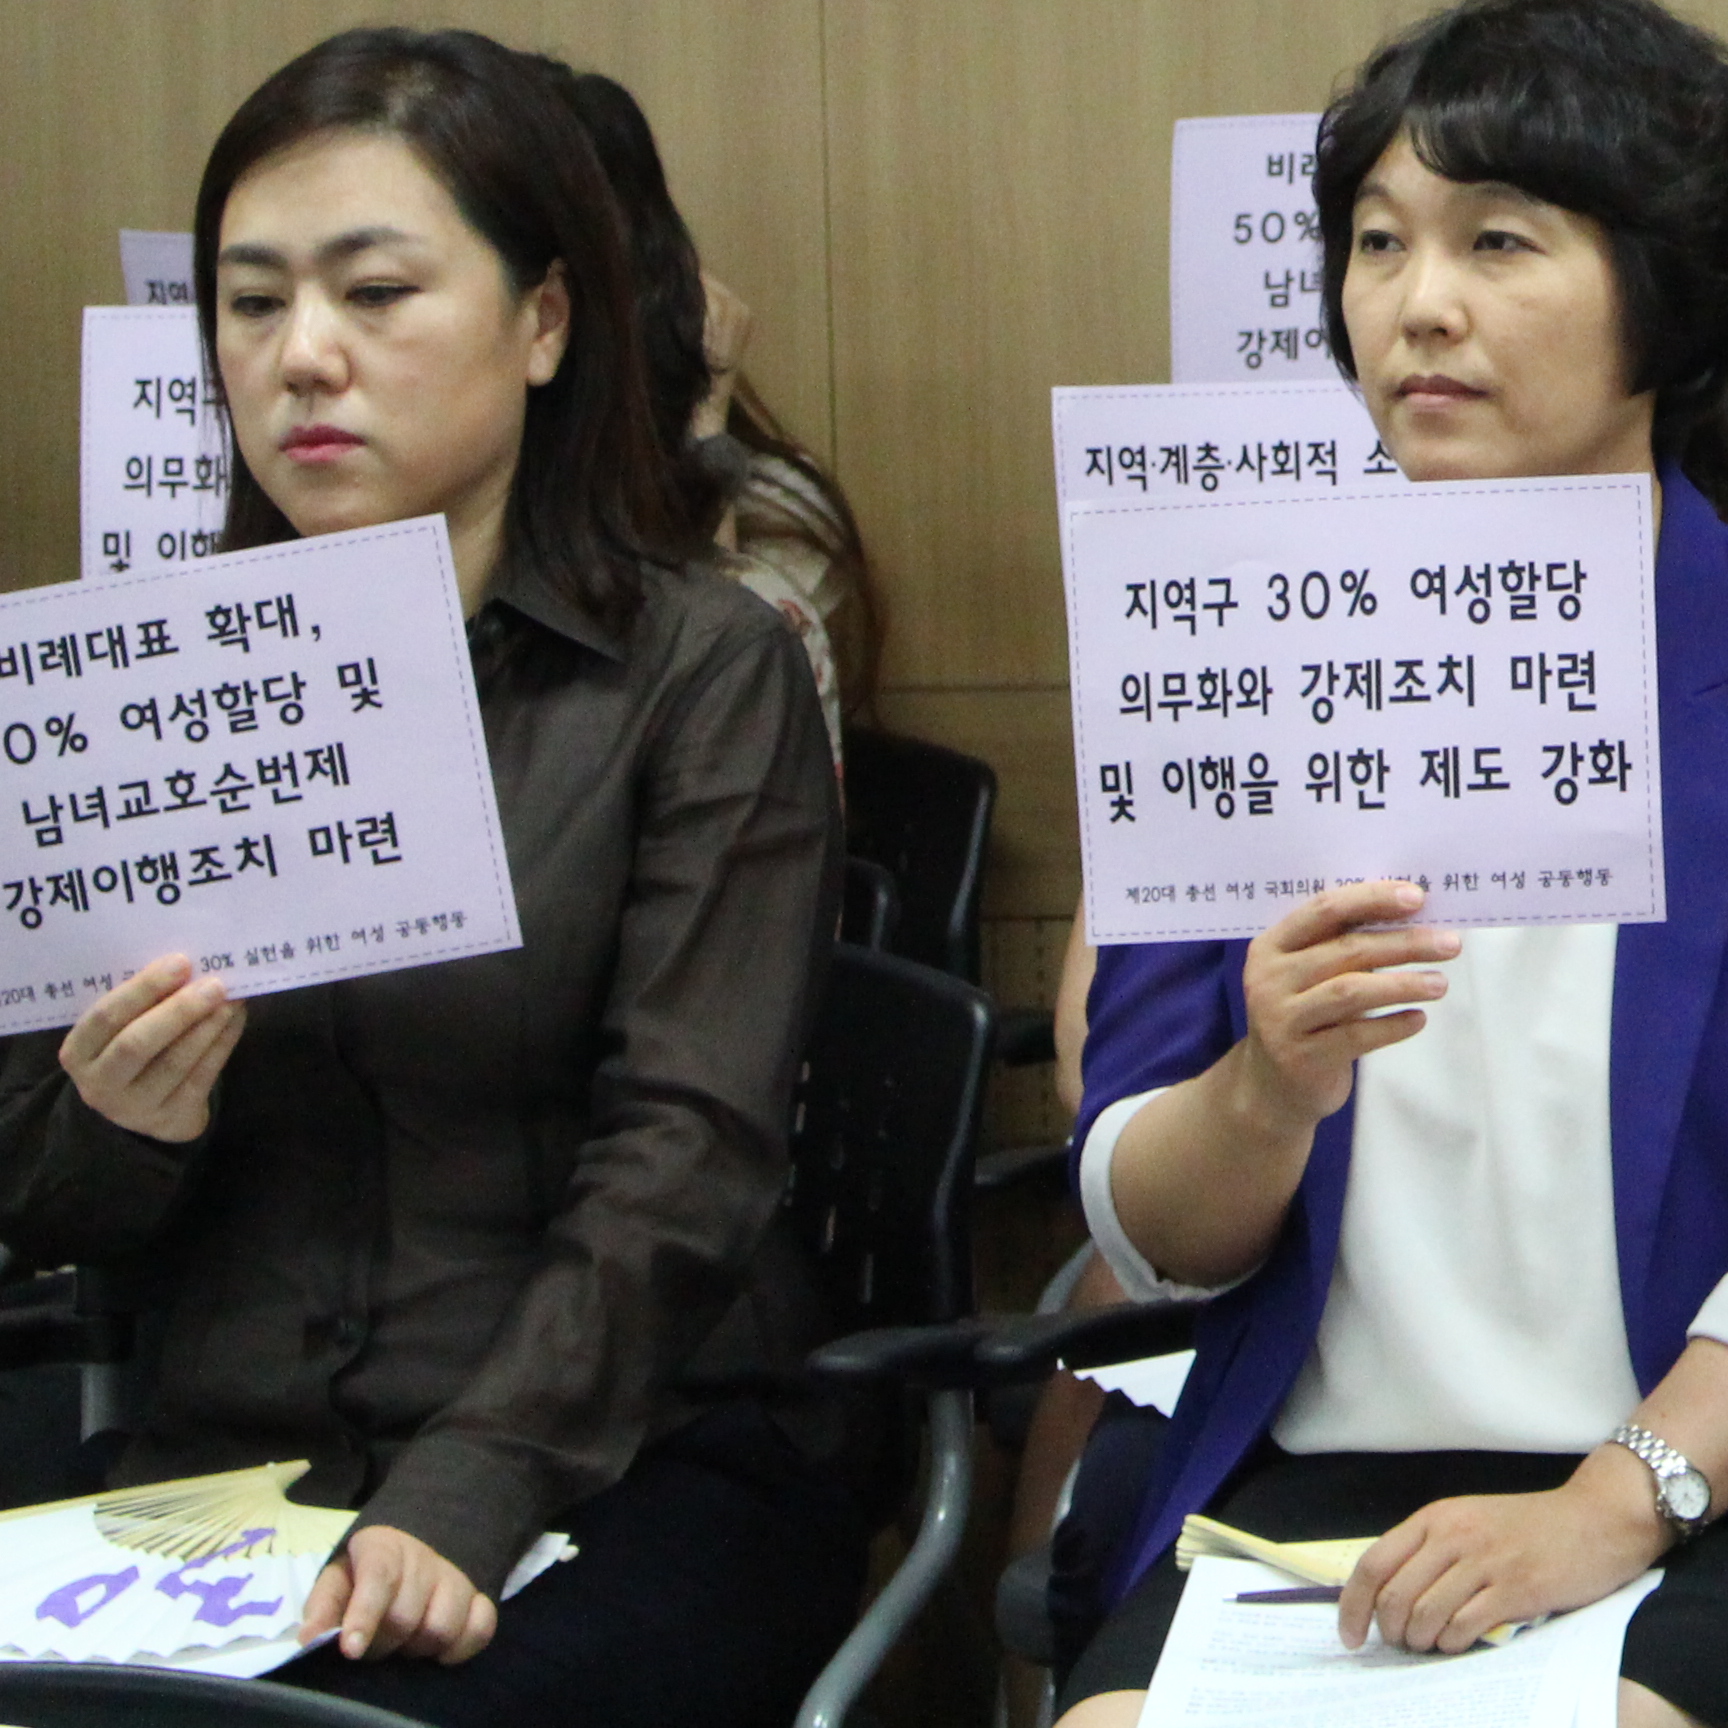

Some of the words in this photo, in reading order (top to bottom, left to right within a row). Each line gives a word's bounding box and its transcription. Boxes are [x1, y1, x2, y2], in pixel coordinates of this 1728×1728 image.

[123, 454, 230, 498] 의무화
[205, 594, 320, 653] 확대,
[1126, 577, 1238, 635] 지역구
[1268, 569, 1377, 621] 30%
[1411, 560, 1587, 624] 여성할당
[4, 713, 88, 765] 0%
[120, 672, 306, 743] 여성할당
[337, 658, 382, 712] 및
[1120, 666, 1273, 722] 의무화와
[1301, 655, 1474, 724] 강제조치
[1511, 651, 1596, 711] 마련
[22, 742, 351, 848] 남녀교호순번제
[1100, 762, 1135, 823] 및
[1163, 753, 1278, 819] 이행을
[1306, 748, 1390, 809] 위한
[1420, 746, 1510, 798] 제도
[1542, 739, 1632, 805] 강화
[3, 833, 278, 930] 강제이행조치
[308, 812, 402, 865] 마련
